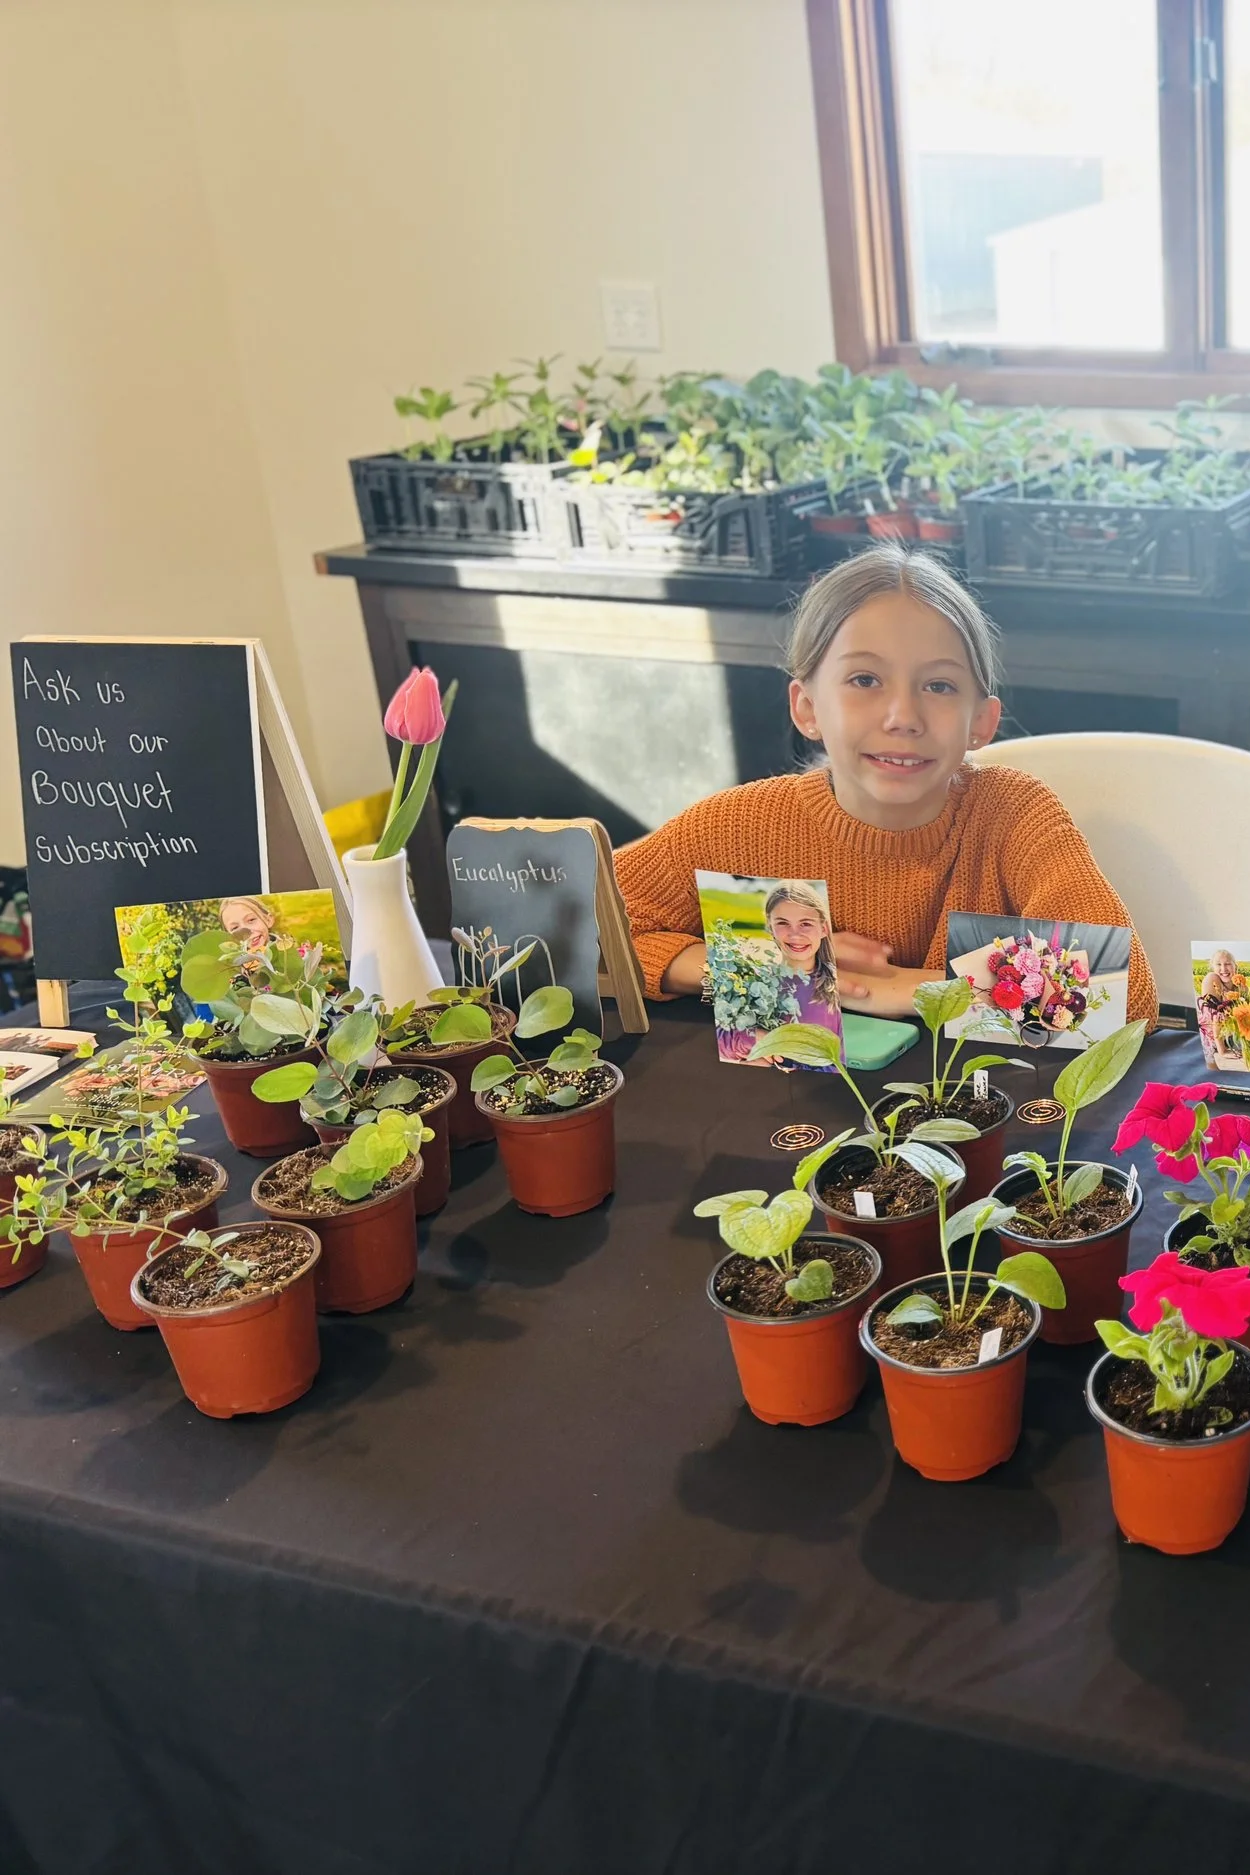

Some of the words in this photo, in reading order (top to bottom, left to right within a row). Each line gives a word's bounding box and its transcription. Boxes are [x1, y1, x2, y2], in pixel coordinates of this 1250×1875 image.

[23, 656, 81, 705] Ask
[96, 681, 126, 704] us
[129, 733, 169, 754] our
[31, 769, 174, 829] Bouquet
[35, 831, 198, 868] Subscription
[451, 856, 567, 893] Eucalyptus
